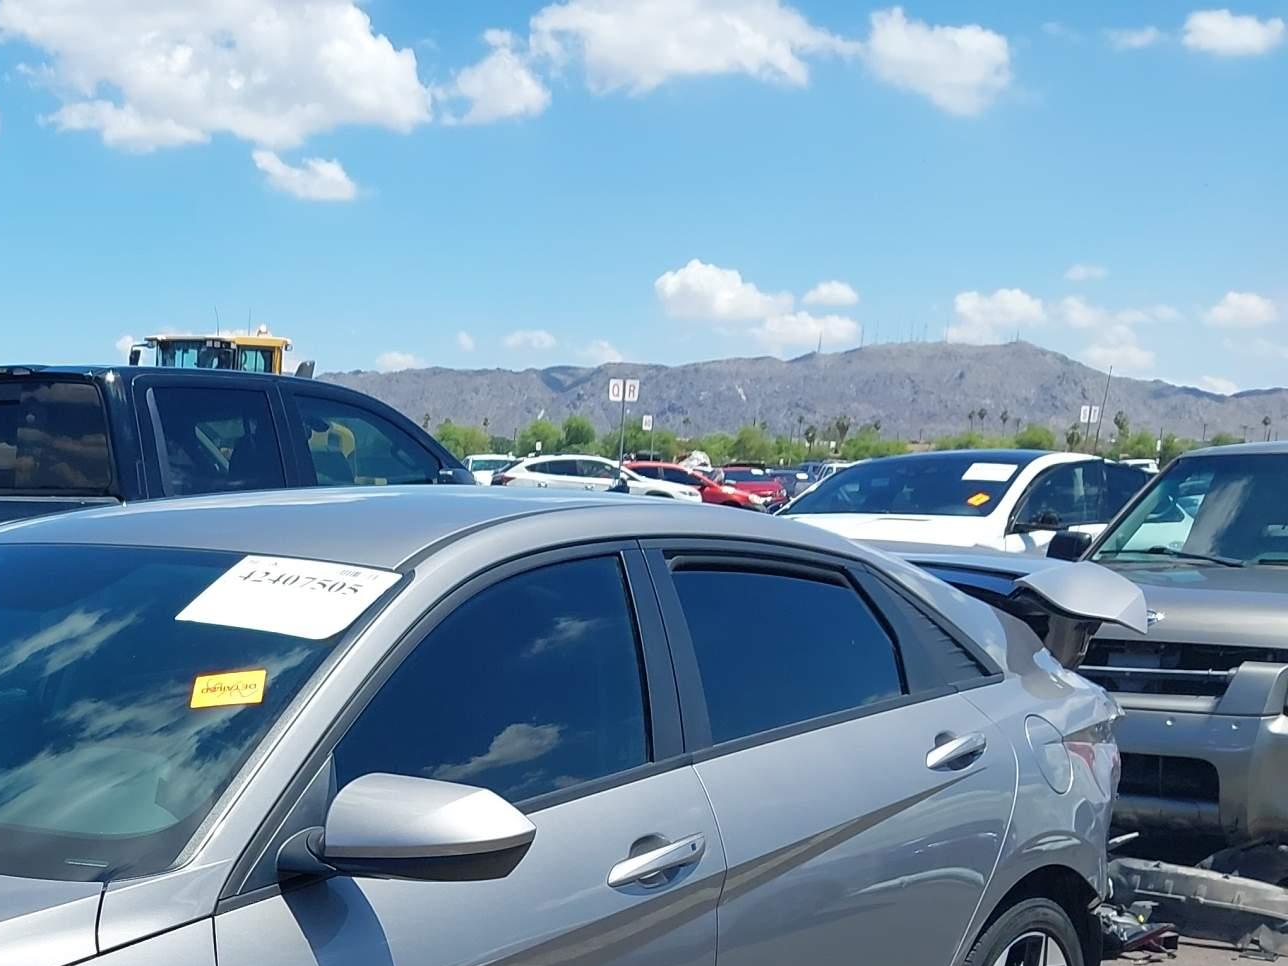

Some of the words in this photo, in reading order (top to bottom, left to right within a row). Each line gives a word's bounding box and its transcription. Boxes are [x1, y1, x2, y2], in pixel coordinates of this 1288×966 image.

[612, 383, 620, 398] Q
[628, 384, 636, 399] R
[239, 569, 364, 596] 42407505
